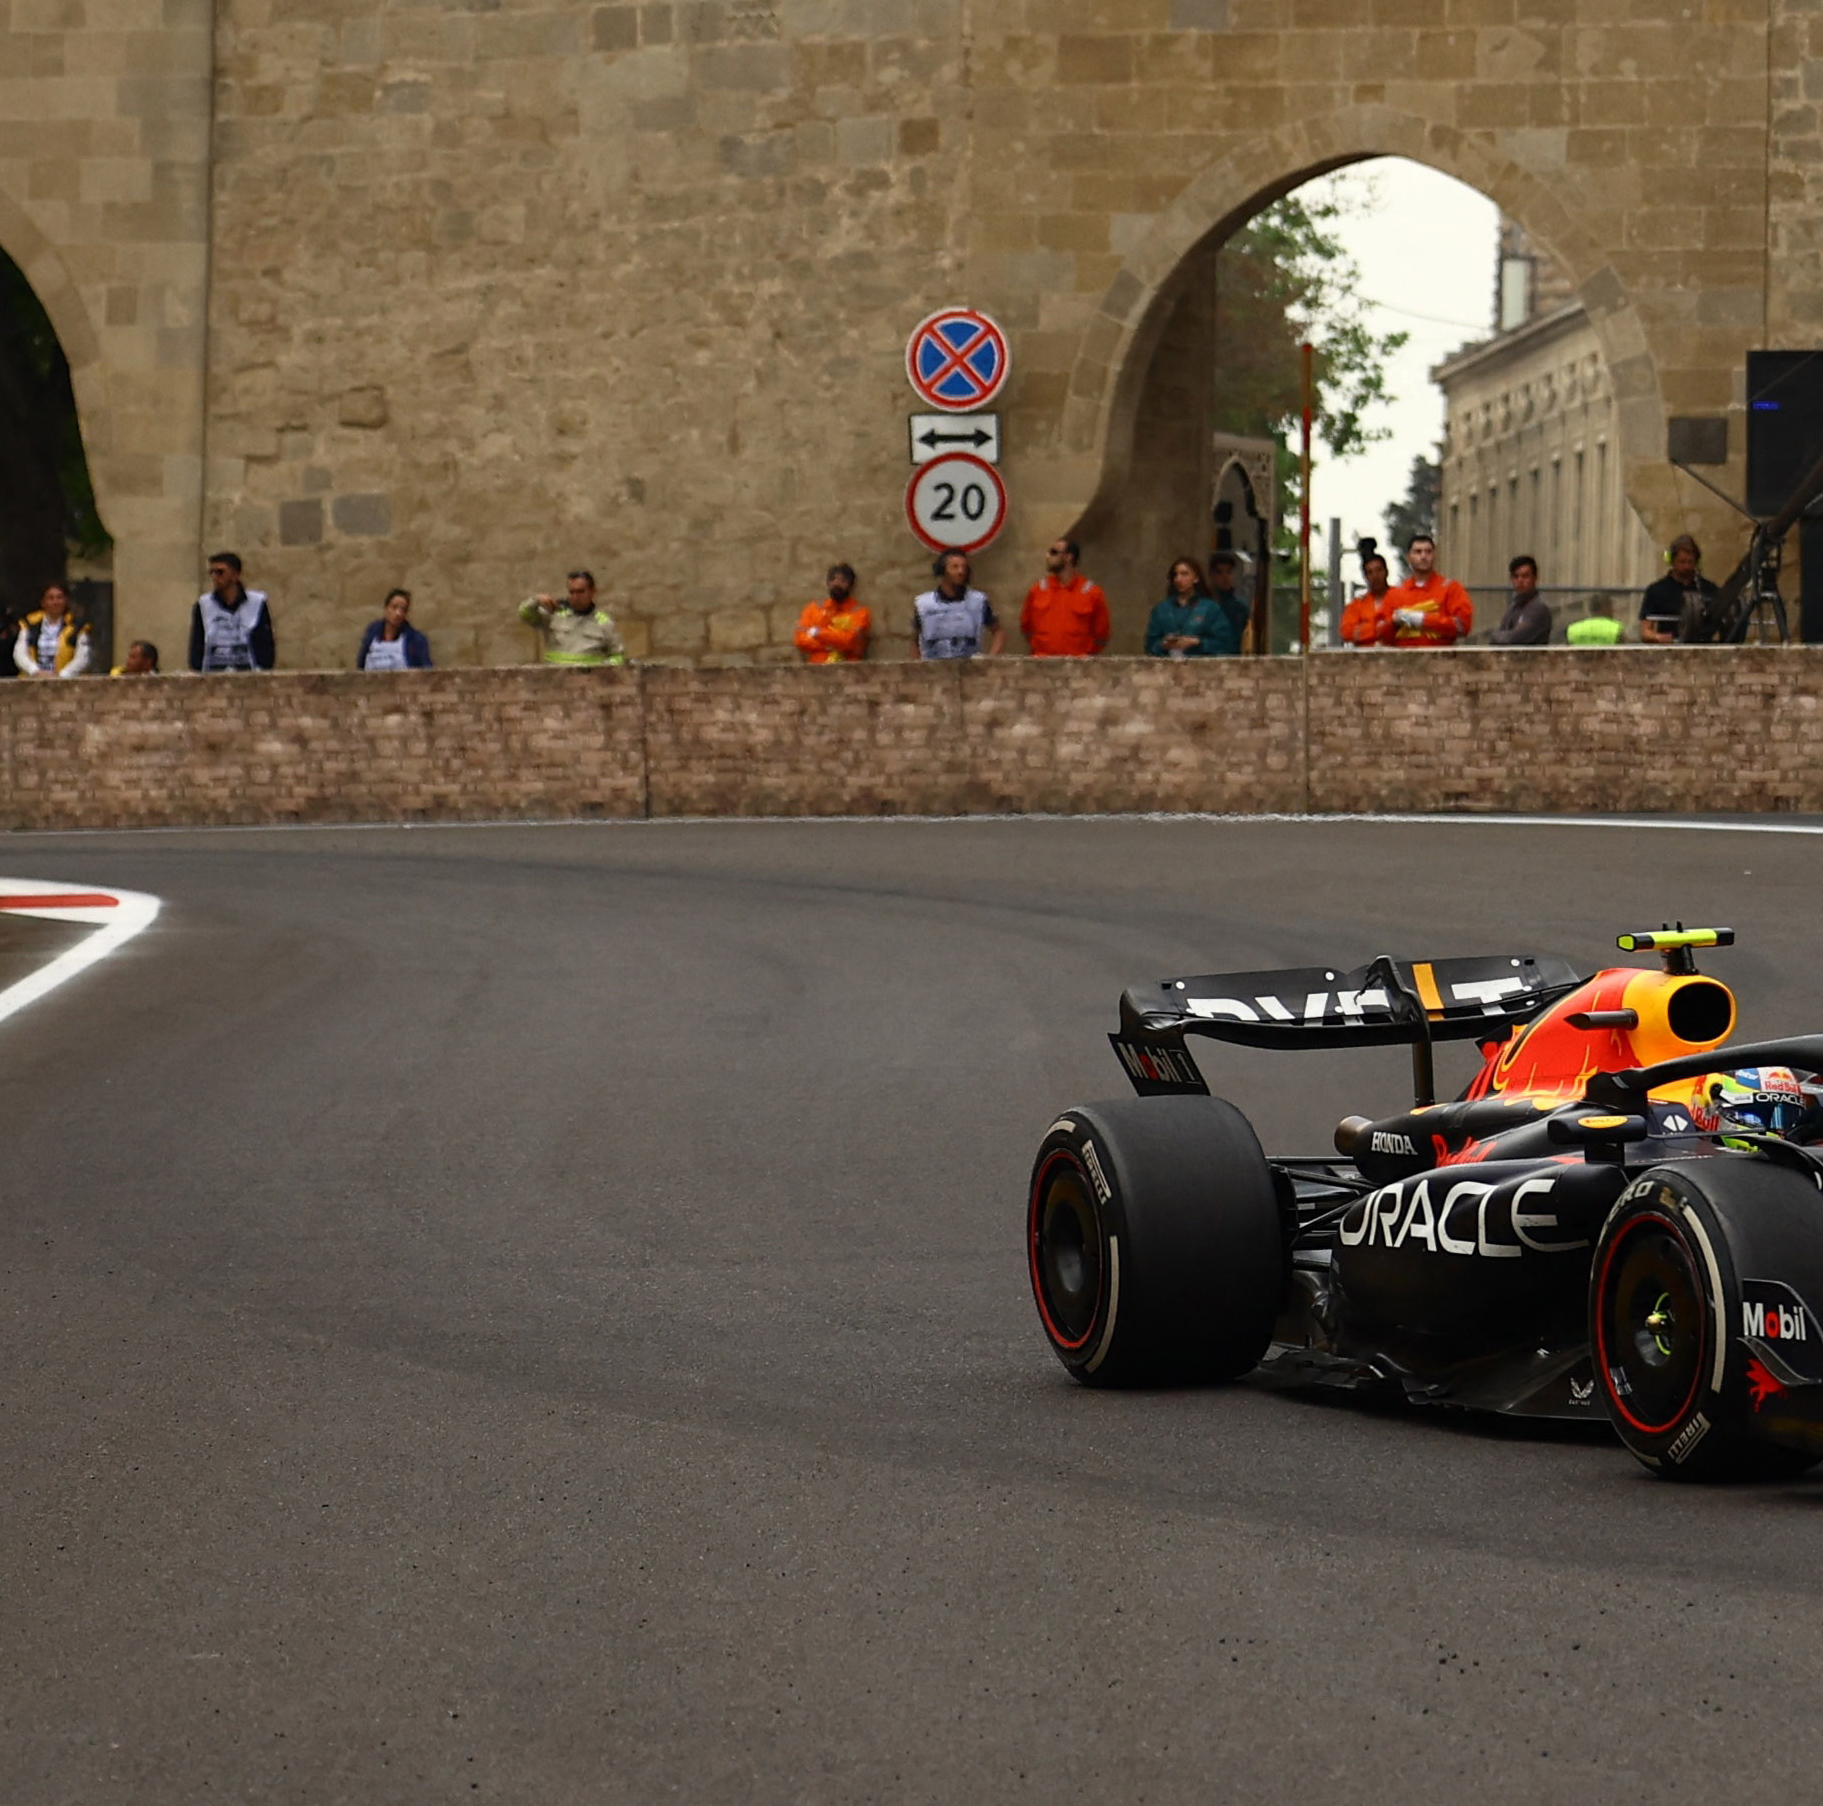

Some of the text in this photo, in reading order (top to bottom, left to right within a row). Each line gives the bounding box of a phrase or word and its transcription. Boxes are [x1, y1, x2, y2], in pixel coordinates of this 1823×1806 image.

[931, 482, 986, 521] 20
[1118, 1040, 1182, 1083] Mobil
[1765, 1081, 1783, 1092] Red
[1371, 1131, 1418, 1155] HONDA
[1339, 1179, 1590, 1258] ORACLE
[1742, 1301, 1807, 1340] Mobil
